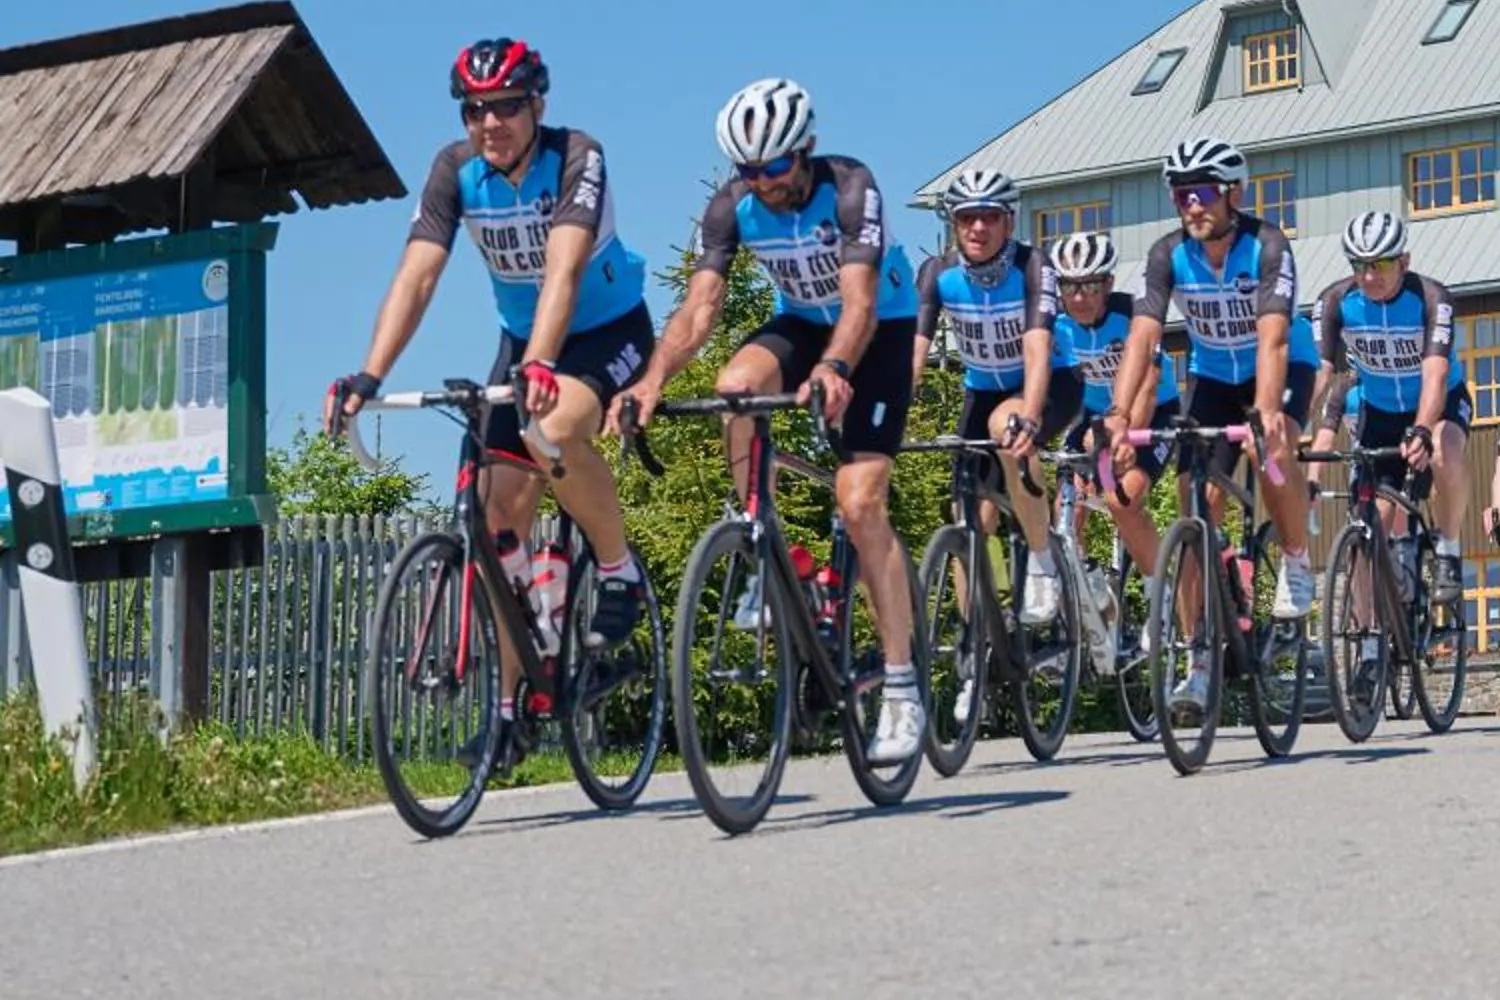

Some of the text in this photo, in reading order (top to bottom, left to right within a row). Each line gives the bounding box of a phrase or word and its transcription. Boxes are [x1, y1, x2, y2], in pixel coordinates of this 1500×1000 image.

[481, 226, 519, 250] CLUB
[798, 274, 840, 300] COU
[1187, 296, 1256, 319] CLUB TÊTE
